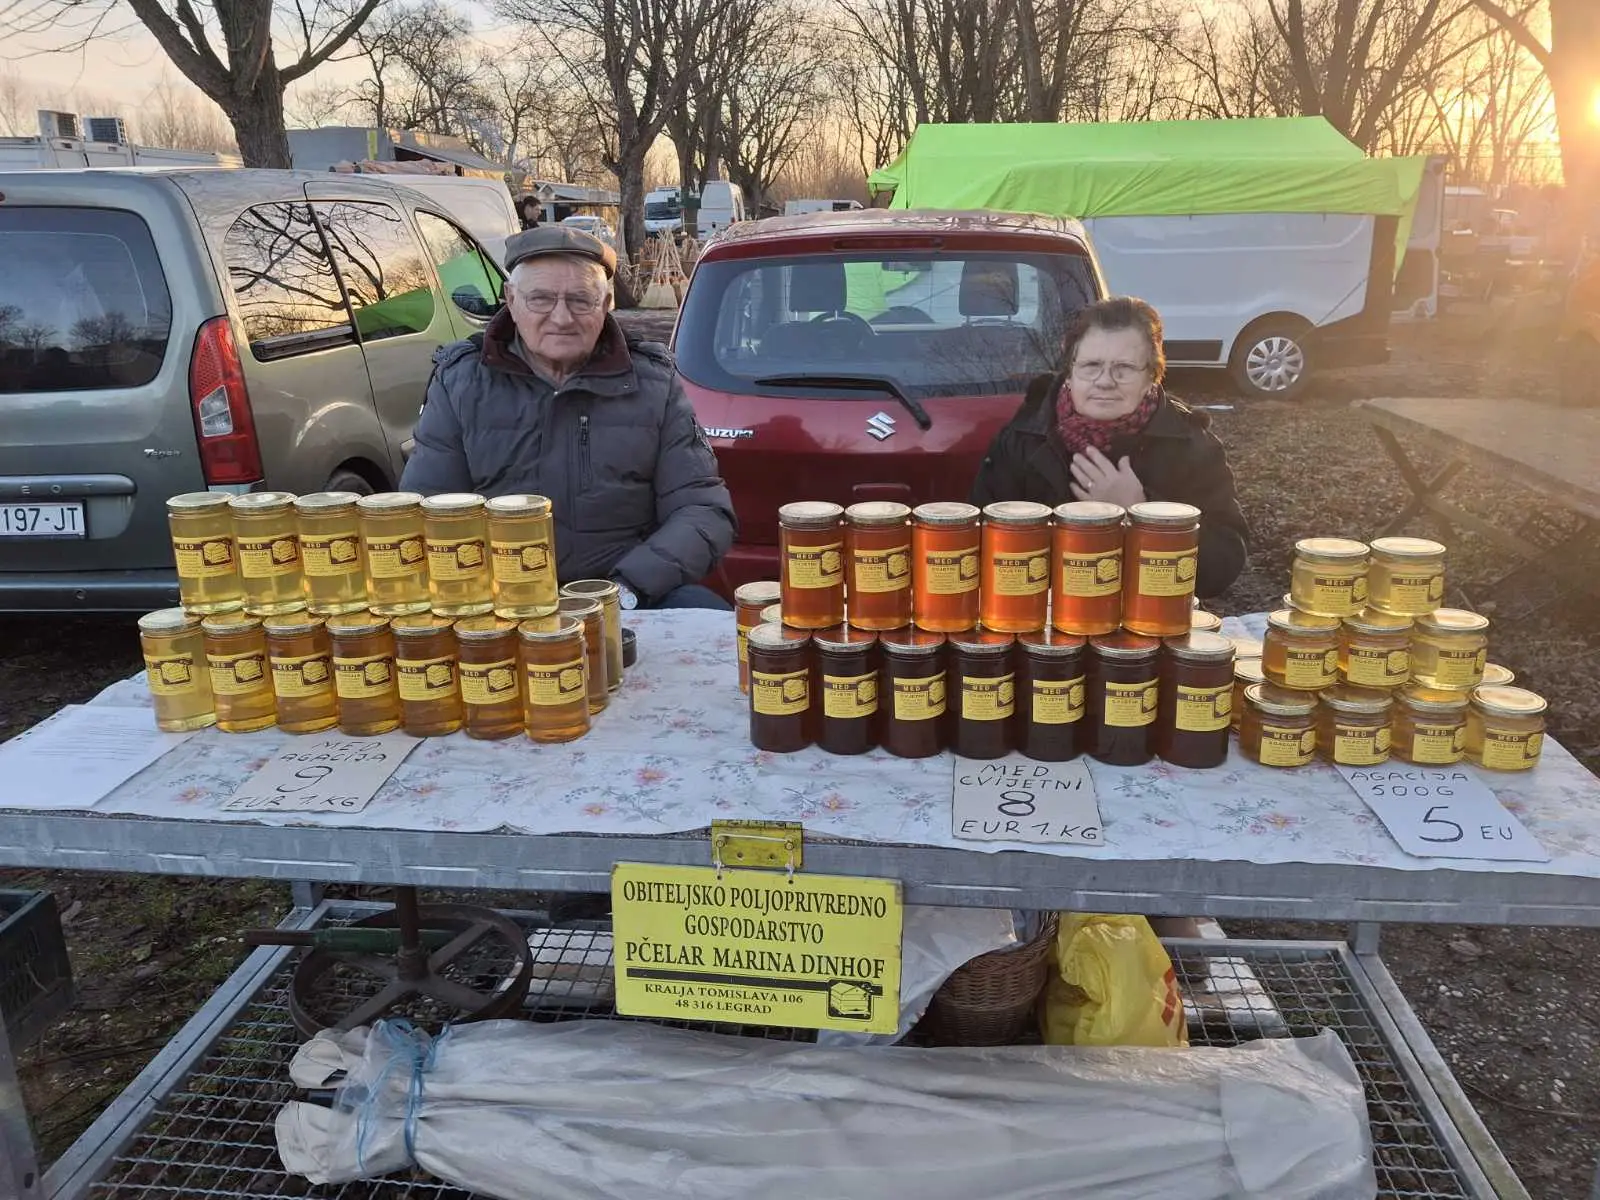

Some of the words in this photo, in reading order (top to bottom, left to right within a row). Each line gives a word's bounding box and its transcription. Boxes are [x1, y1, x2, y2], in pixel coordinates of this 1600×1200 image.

[1274, 732, 1293, 740] MED
[312, 741, 382, 751] MED
[281, 753, 387, 762] AGACIJA
[980, 764, 1049, 777] MED
[1350, 771, 1469, 781] AGACIJA
[276, 765, 333, 792] 9
[959, 775, 1082, 790] CVIJETNI
[1371, 784, 1454, 796] 500G
[228, 796, 286, 808] EUR
[320, 797, 357, 807] KG
[998, 790, 1036, 816] 8
[960, 820, 1021, 833] EUR
[1060, 825, 1098, 839] KG
[1419, 806, 1464, 843] 5
[1480, 825, 1513, 840] EU
[623, 880, 726, 910] OBITELJSKO
[730, 887, 887, 918] POLJOPRIVREDNO
[685, 914, 824, 944] GOSPODARSTVO
[625, 936, 705, 966] PČELAR
[713, 947, 795, 973] MARINA
[801, 954, 885, 979] DINHOF
[645, 983, 694, 996] KRALJA
[697, 986, 778, 1003] TOMISLAVA
[782, 994, 803, 1004] 106
[675, 999, 690, 1008] 48
[692, 1000, 713, 1010] 316
[717, 1002, 772, 1014] LEGRAD
